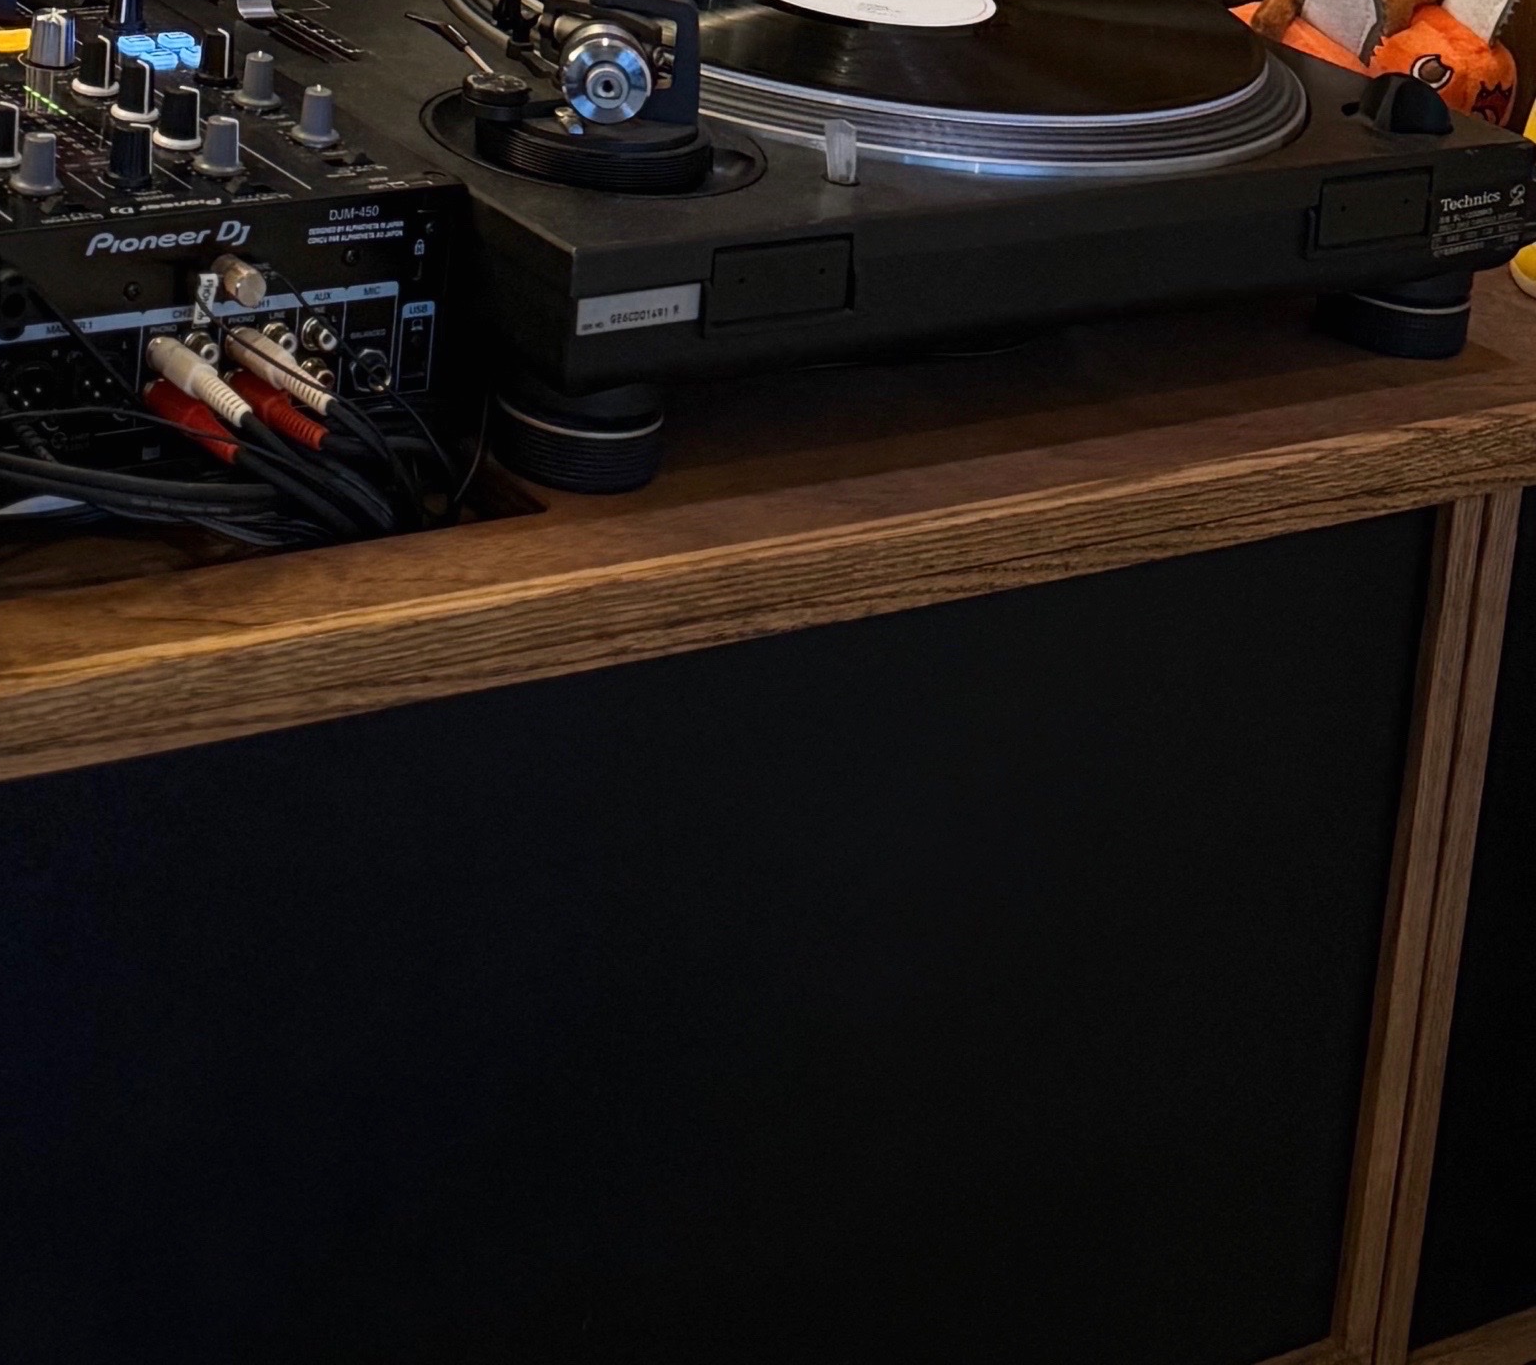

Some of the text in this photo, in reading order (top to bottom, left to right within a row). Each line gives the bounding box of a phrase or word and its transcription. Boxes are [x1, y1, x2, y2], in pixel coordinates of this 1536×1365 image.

[1440, 190, 1502, 212] Technics
[328, 204, 380, 221] DJM-450
[85, 229, 212, 257] Pioneer
[313, 291, 332, 302] AUX
[408, 303, 428, 315] USB
